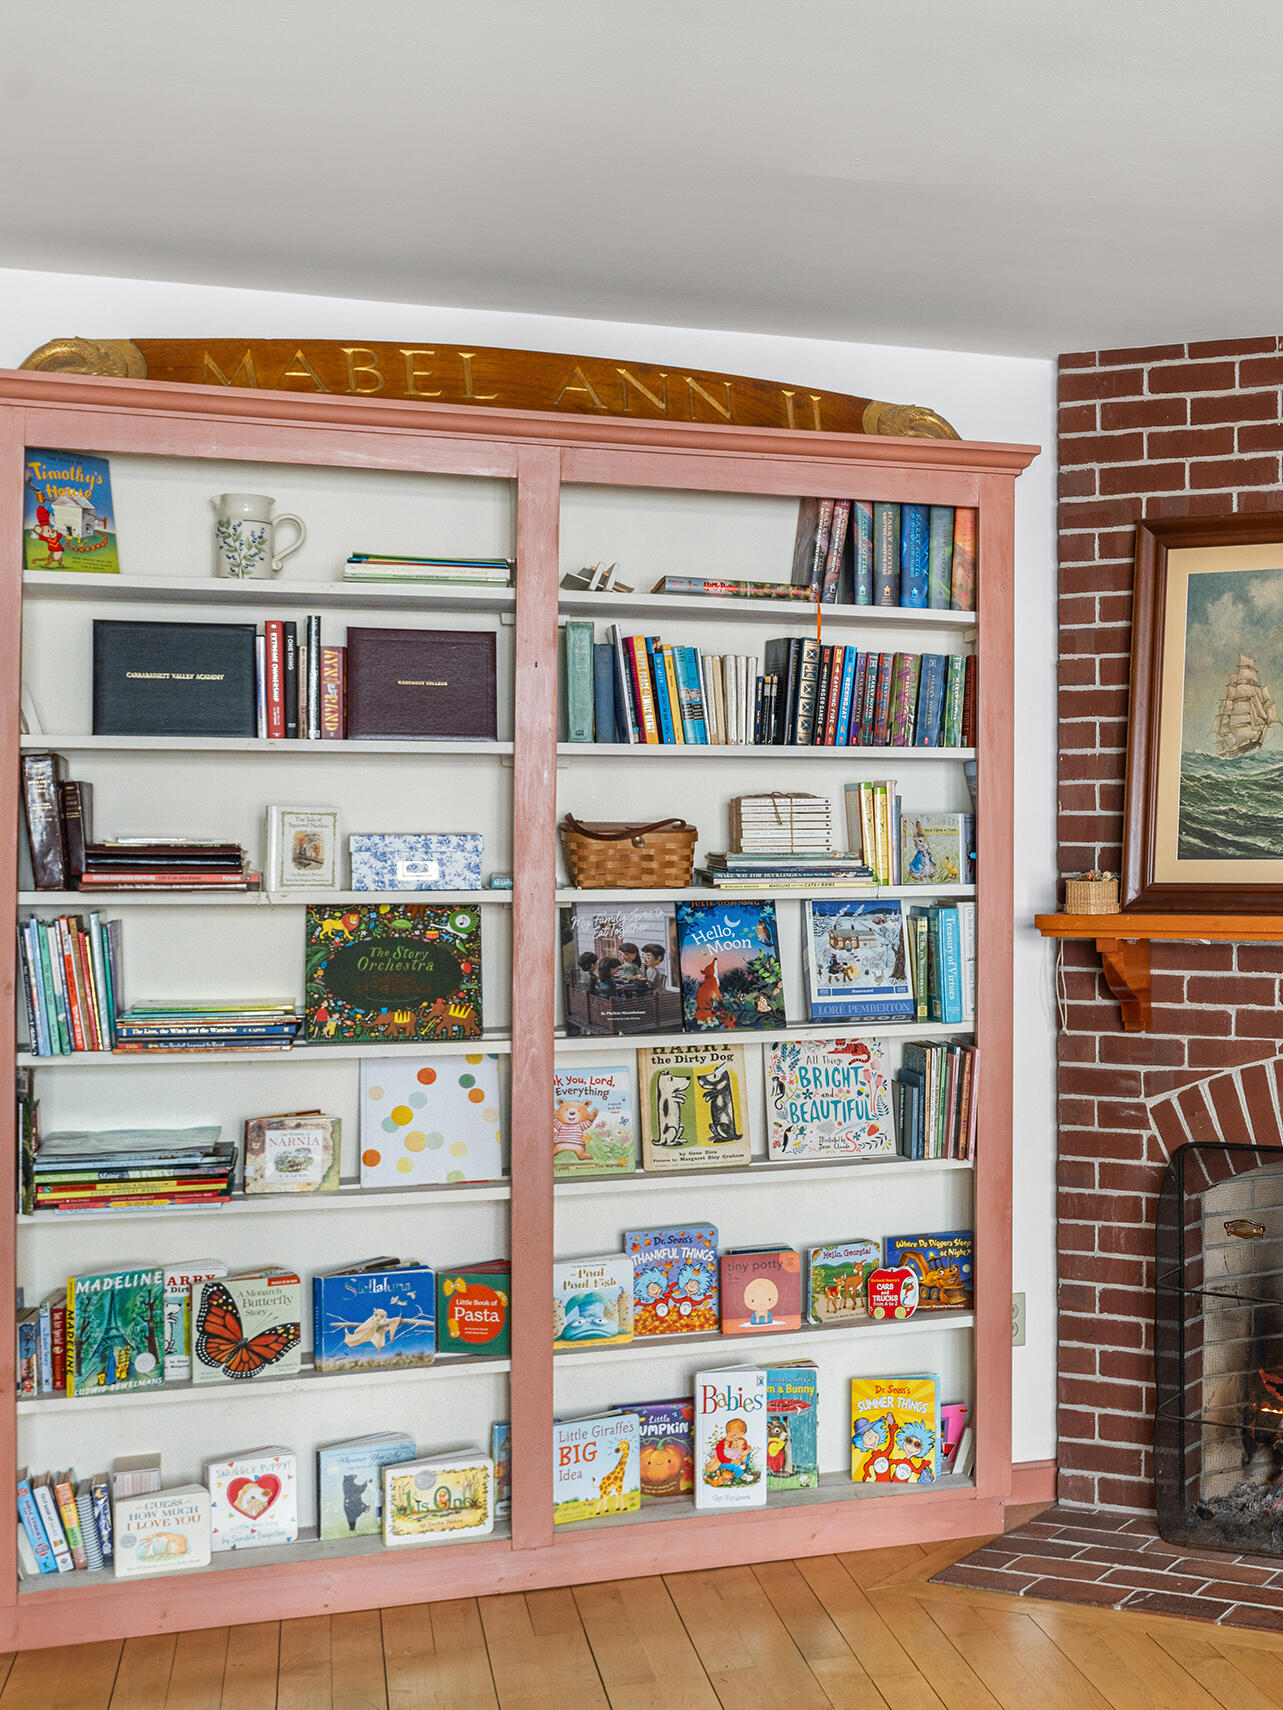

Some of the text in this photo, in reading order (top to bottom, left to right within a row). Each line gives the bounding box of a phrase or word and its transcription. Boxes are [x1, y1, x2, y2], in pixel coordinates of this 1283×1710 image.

[203, 347, 822, 431] MABEL ANN II
[28, 461, 103, 491] Timothy's
[46, 484, 93, 499] House
[270, 632, 278, 662] EXTREME
[172, 672, 224, 681] VALLEY ACADEMY
[324, 650, 339, 731] AYN RAND
[832, 676, 840, 706] CATCHING
[842, 677, 852, 720] MOCKINGJAY
[570, 910, 628, 931] My Family
[592, 922, 650, 940] Eat Together
[692, 924, 736, 946] Hello,
[370, 946, 430, 960] The Story
[706, 938, 752, 956] Moon
[357, 956, 435, 972] Orchestra
[945, 916, 958, 1000] Treasury of Virtues
[818, 1002, 910, 1016] LORÉ PEMBERTON
[188, 1026, 198, 1034] and
[200, 1026, 208, 1034] the
[210, 1026, 238, 1034] Wardrobe
[651, 1053, 734, 1065] the Dirty Dog
[806, 1054, 843, 1066] All Things
[590, 1074, 616, 1088] Lord,
[800, 1066, 864, 1088] BRIGHT
[556, 1086, 610, 1100] Everything
[820, 1090, 834, 1098] and
[790, 1098, 875, 1124] BEAUTIFUL
[269, 1136, 320, 1147] NARNIA
[654, 1235, 693, 1246] Dr. Seuss's
[895, 1239, 953, 1249] Where Do Diggers
[632, 1246, 715, 1266] THANKFUL THINGS
[844, 1247, 872, 1257] Georgia!
[947, 1249, 972, 1258] Night?
[578, 1268, 605, 1278] Pout
[727, 1260, 783, 1273] tiny potty
[76, 1270, 163, 1294] MADELINE
[344, 1277, 410, 1300] Stellaluna
[563, 1276, 617, 1290] Pout Fish
[246, 1288, 282, 1298] Monarch
[242, 1295, 294, 1308] Butterfly
[456, 1298, 472, 1306] Little
[245, 1308, 266, 1317] Story
[454, 1306, 500, 1322] Pasta
[66, 1310, 74, 1376] MADELINE
[74, 1376, 164, 1396] LUDWIG BEMELMANS
[786, 1384, 814, 1398] Bunny
[874, 1385, 911, 1394] Dr. Seuss's
[700, 1384, 764, 1414] Babies
[856, 1397, 894, 1414] SUMMER
[648, 1416, 670, 1424] Little
[558, 1420, 634, 1444] Little Giraffe's
[640, 1422, 689, 1436] UMPKiN
[369, 1452, 386, 1465] You
[558, 1442, 598, 1466] BIG
[214, 1460, 292, 1480] SNUGGLE PUPPY!
[558, 1470, 584, 1482] Idea
[144, 1498, 185, 1510] GUESS
[416, 1500, 430, 1512] is
[128, 1506, 200, 1522] HOW MUCH
[136, 1514, 200, 1530] LOVE YOU
[231, 1529, 287, 1543] Sandra Boynton
